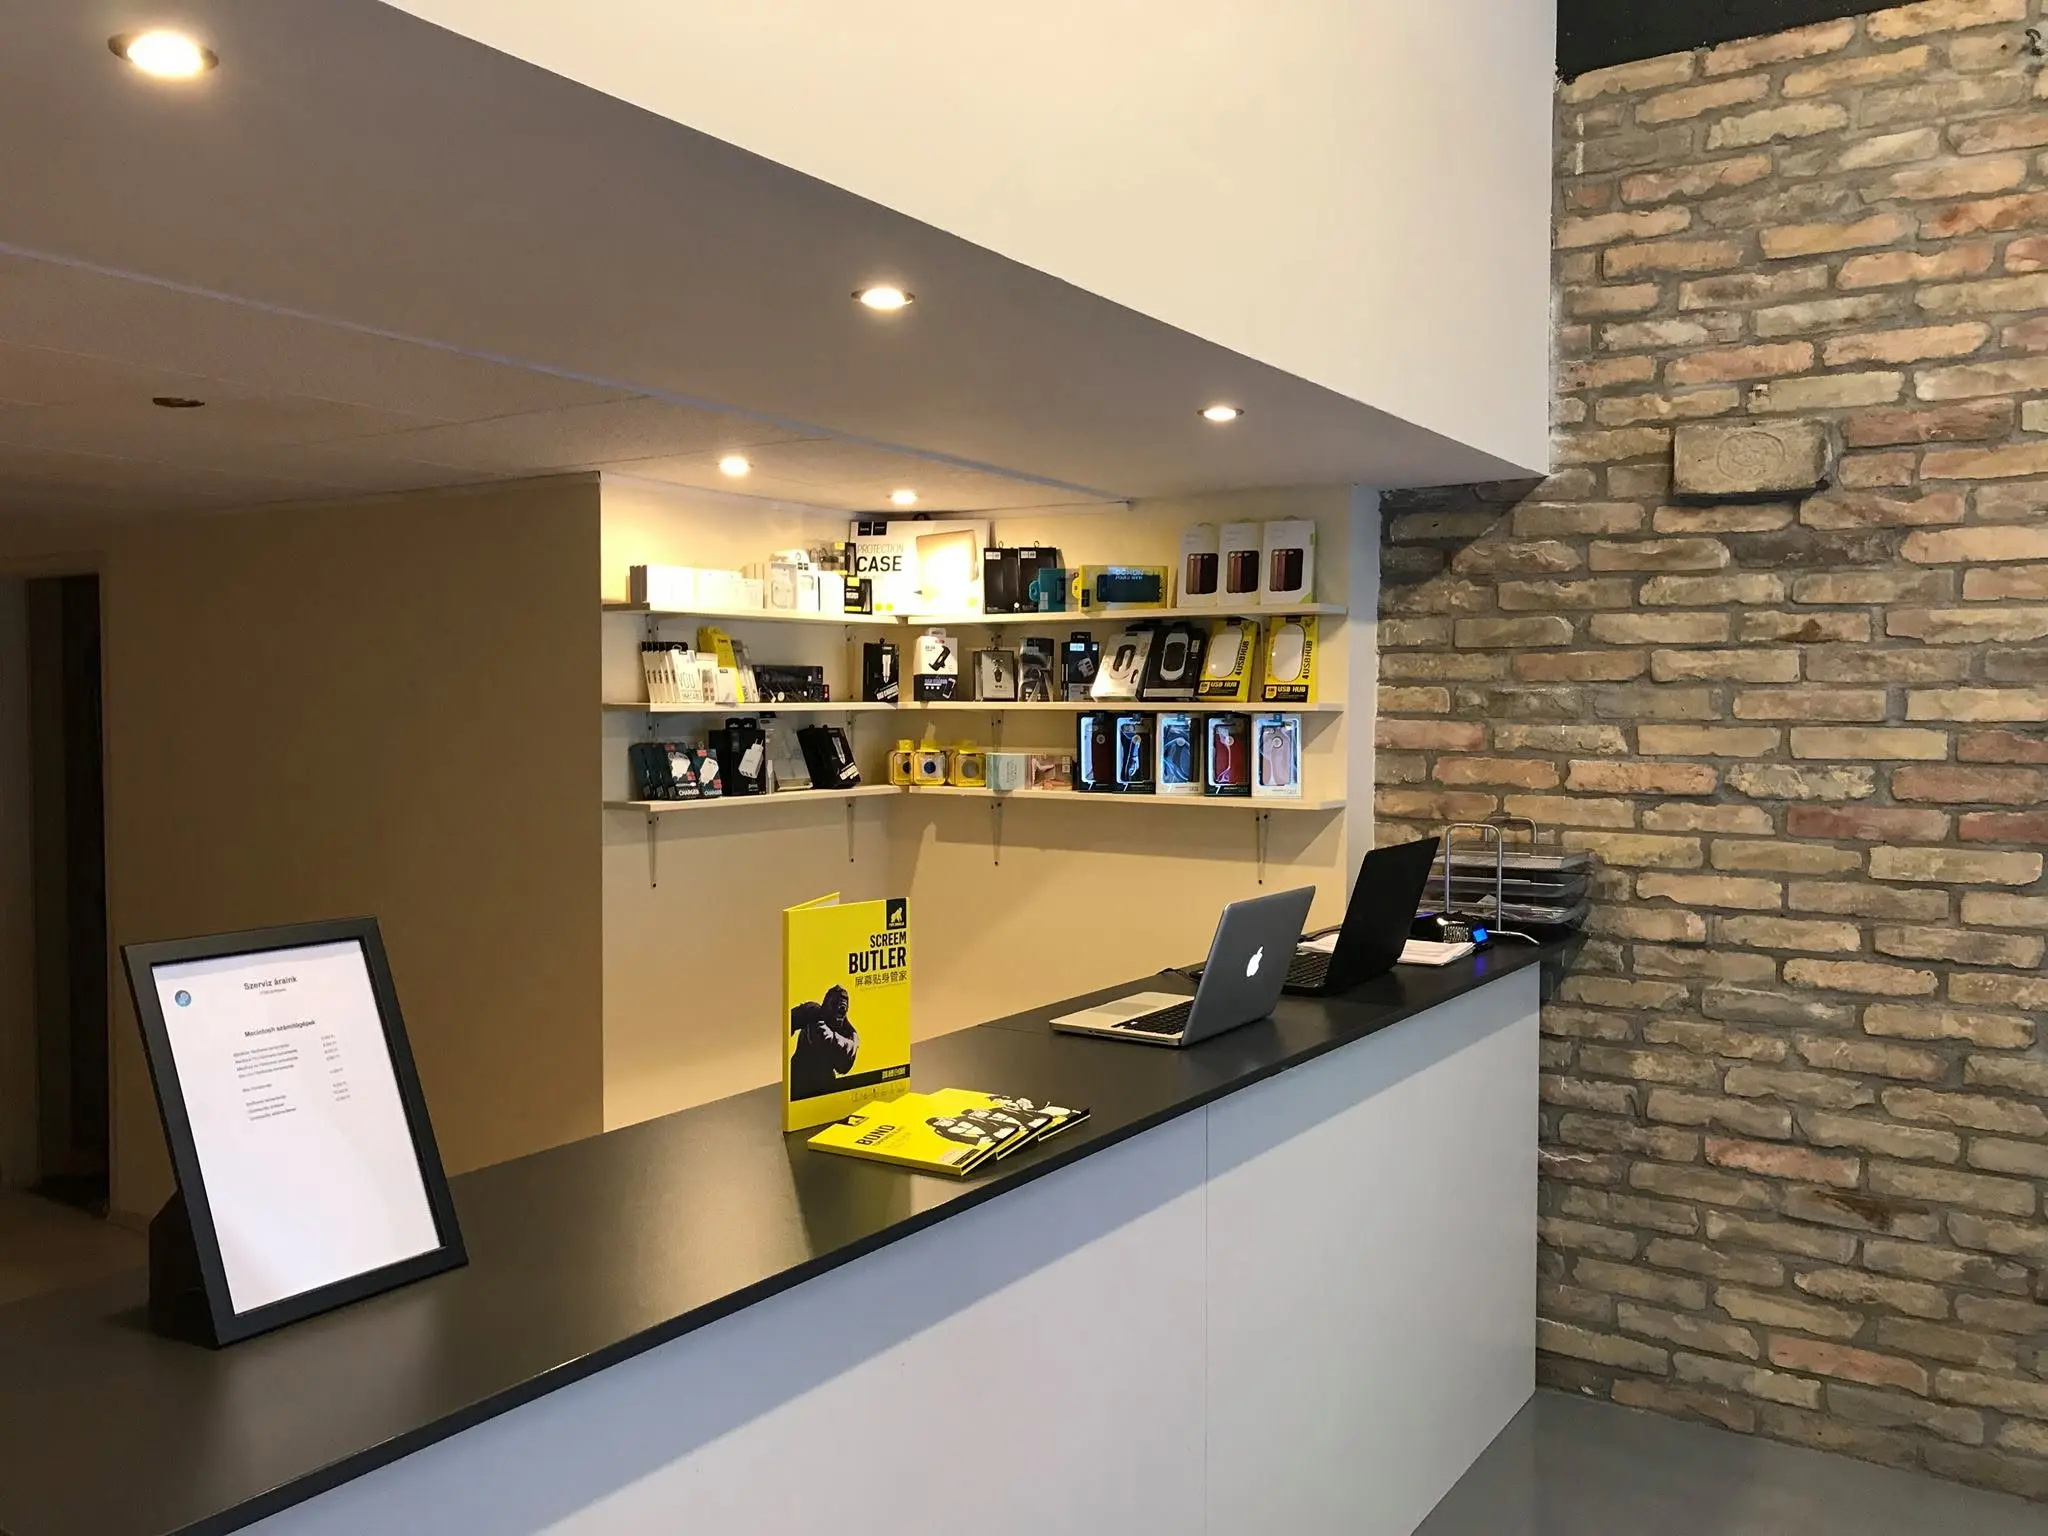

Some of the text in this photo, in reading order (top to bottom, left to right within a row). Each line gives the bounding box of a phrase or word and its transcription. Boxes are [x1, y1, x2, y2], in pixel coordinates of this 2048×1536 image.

[857, 543, 904, 554] PROTECTION
[857, 556, 902, 572] CASE
[870, 931, 907, 948] SCREEM
[848, 947, 907, 975] BUTLER
[243, 976, 297, 990] Szerviz áraink
[855, 1124, 896, 1146] BOND
